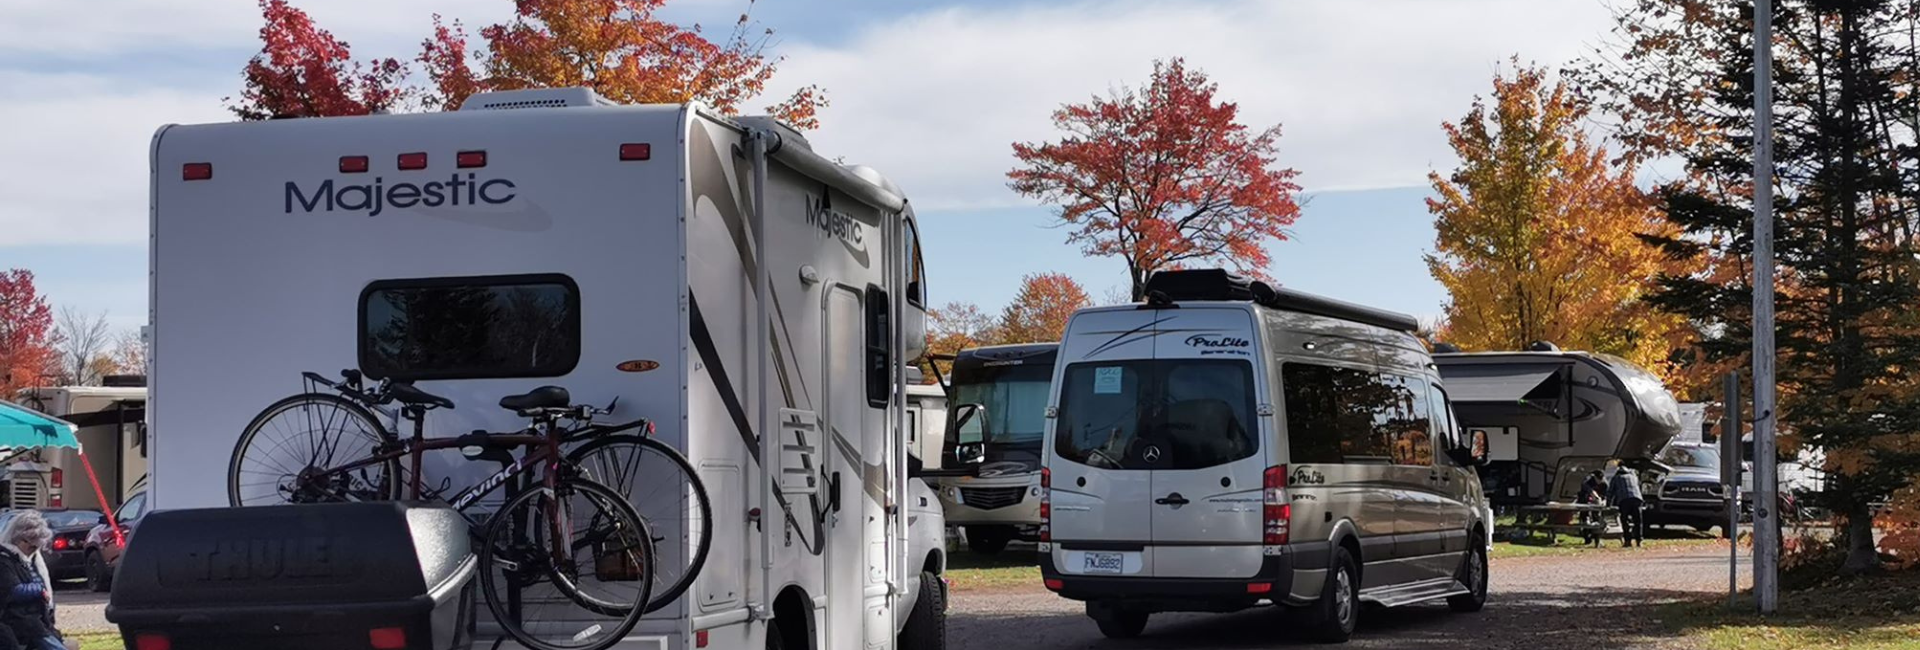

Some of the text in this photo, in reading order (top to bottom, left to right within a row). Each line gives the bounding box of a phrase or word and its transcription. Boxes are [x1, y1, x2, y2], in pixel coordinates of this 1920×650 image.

[285, 173, 516, 217] Majestic
[805, 193, 862, 244] Majestic
[1192, 337, 1249, 347] ProLite
[190, 537, 336, 582] THULE
